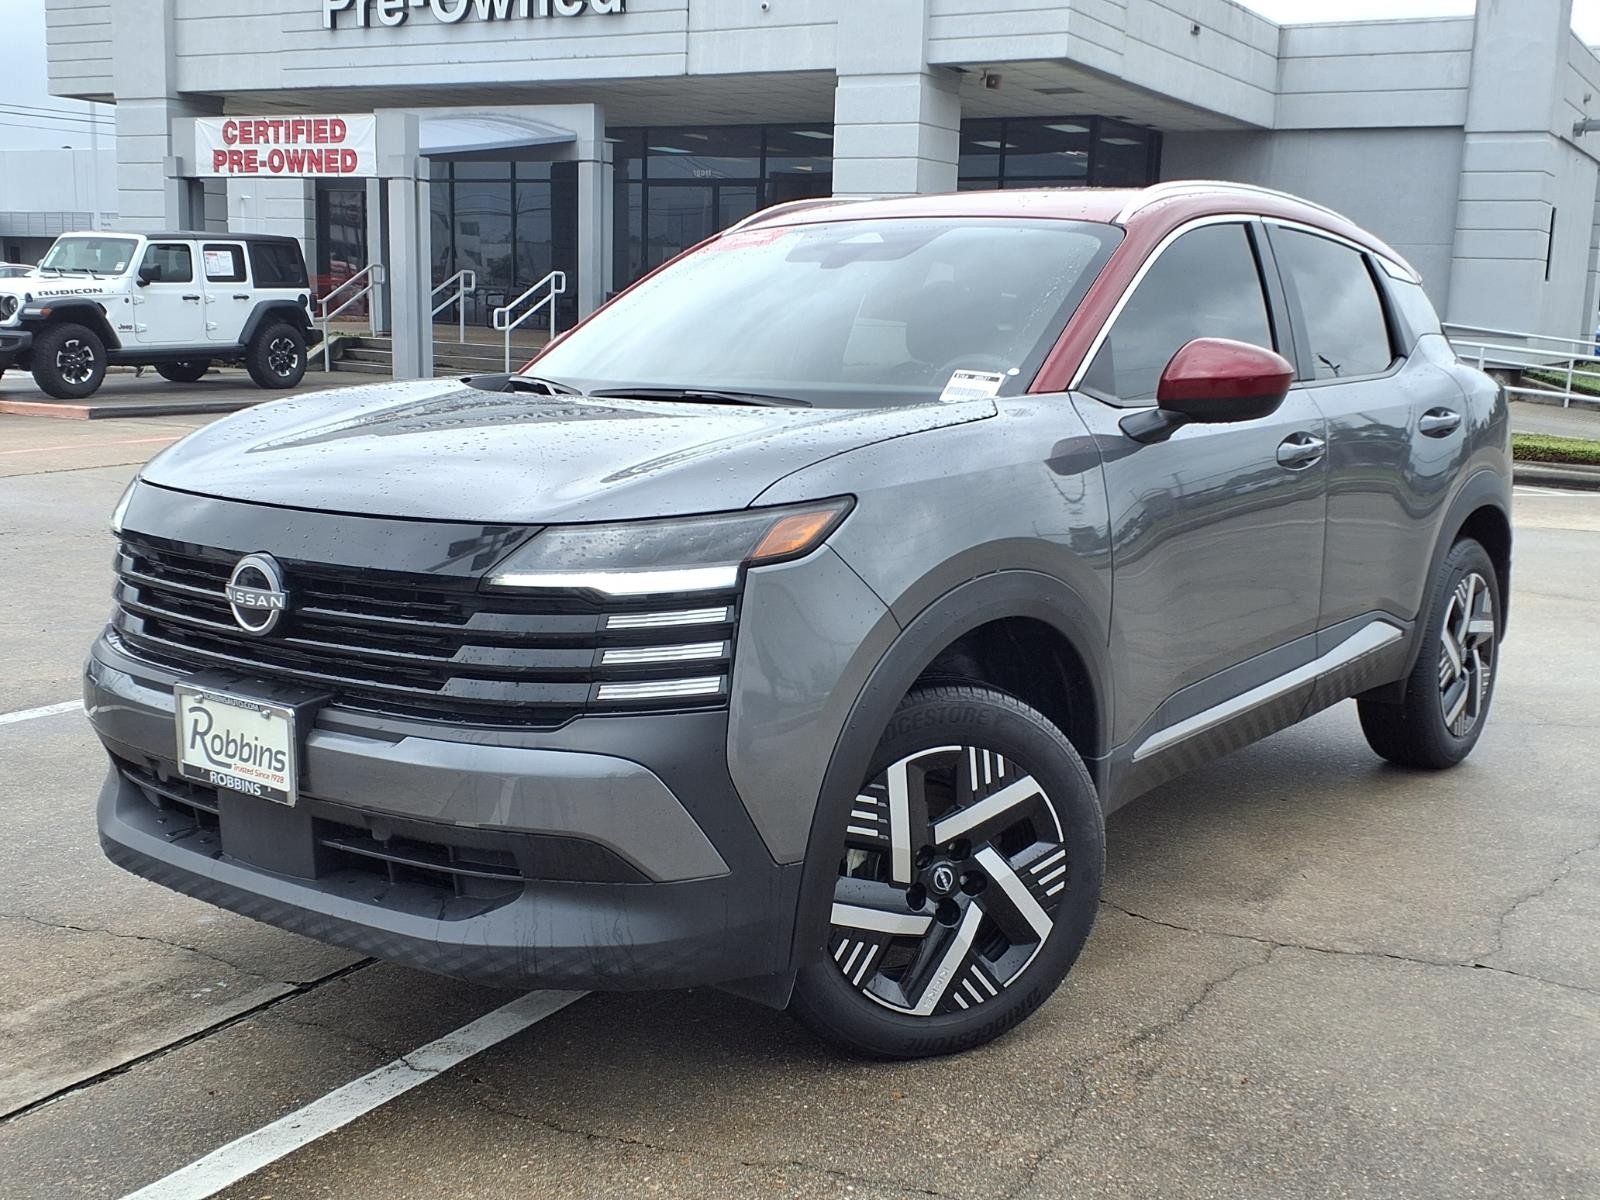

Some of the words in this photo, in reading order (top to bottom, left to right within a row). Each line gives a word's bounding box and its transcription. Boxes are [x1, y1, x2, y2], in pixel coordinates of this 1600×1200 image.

[222, 118, 347, 145] CERTIFIED
[212, 148, 358, 174] PRE-OWNED
[38, 288, 104, 296] RUBICON
[118, 323, 133, 331] Jeep
[225, 587, 283, 608] NISSAN
[188, 706, 287, 772] Robbins
[210, 771, 262, 796] ROBBINS
[233, 763, 254, 776] Trusted
[254, 769, 270, 780] Since
[270, 773, 285, 784] 1928
